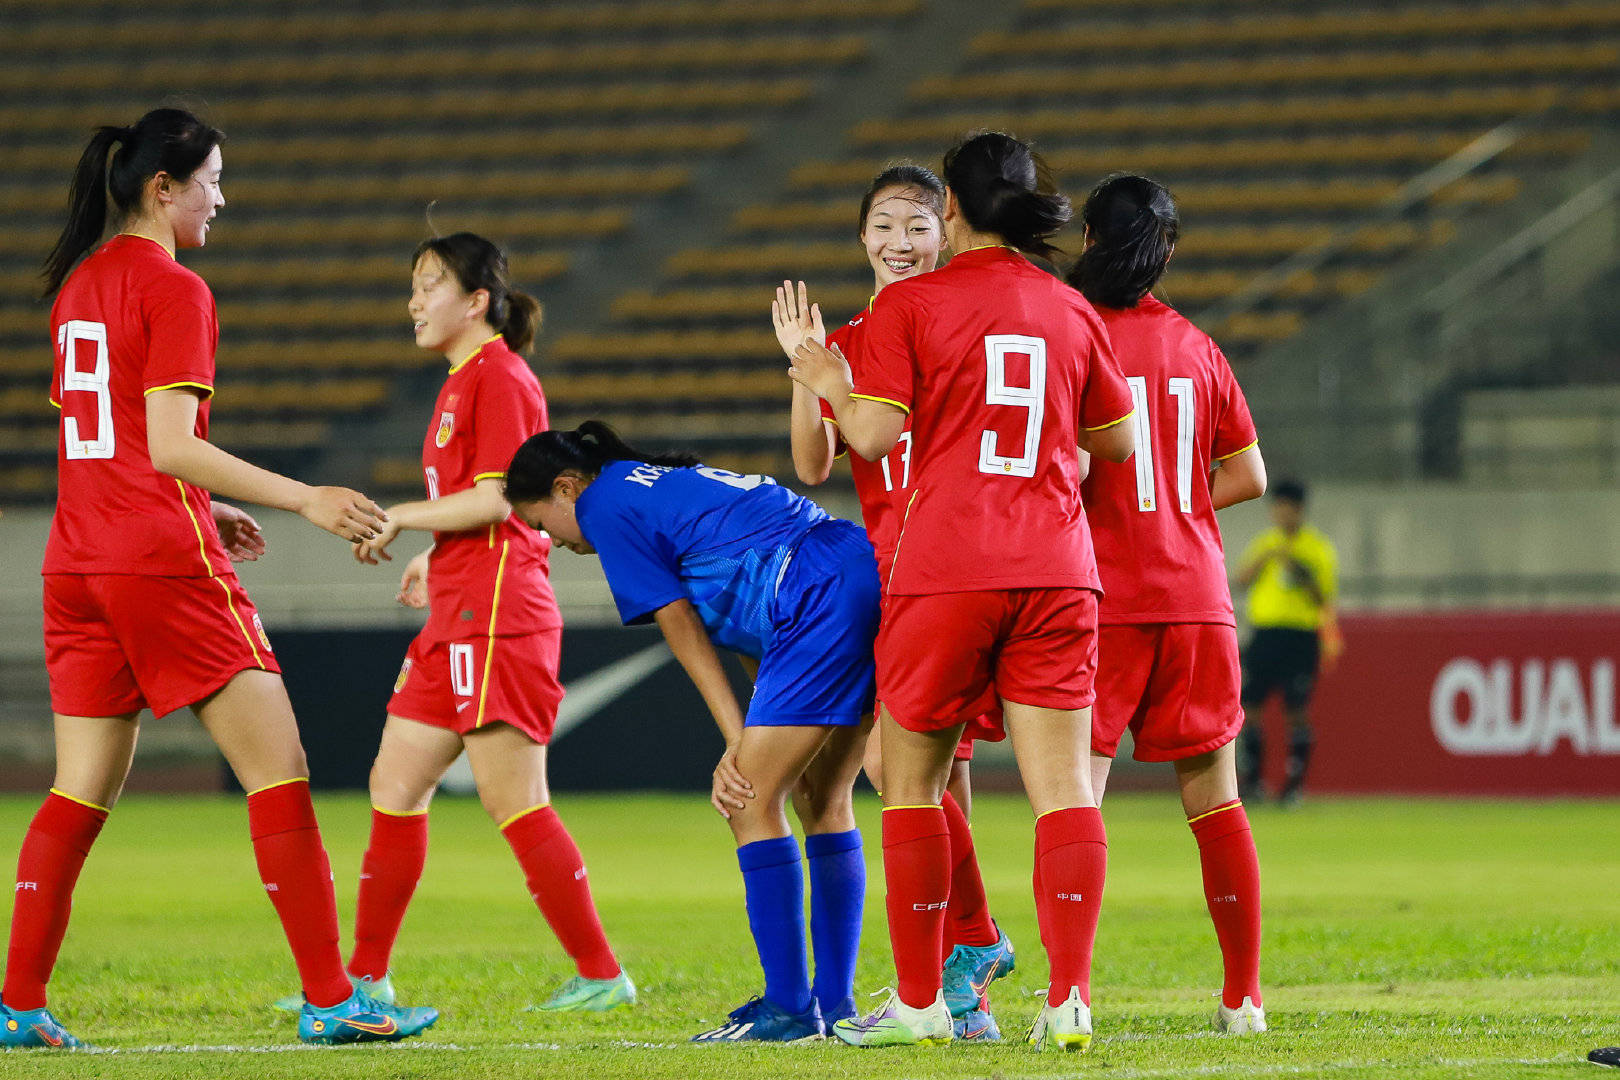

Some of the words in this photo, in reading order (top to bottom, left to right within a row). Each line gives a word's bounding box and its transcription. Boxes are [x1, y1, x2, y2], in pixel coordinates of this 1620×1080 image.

[978, 334, 1047, 478] 9
[1126, 376, 1195, 513] 11
[449, 642, 474, 697] 10
[1430, 656, 1620, 757] QUAL
[912, 901, 948, 911] CFA
